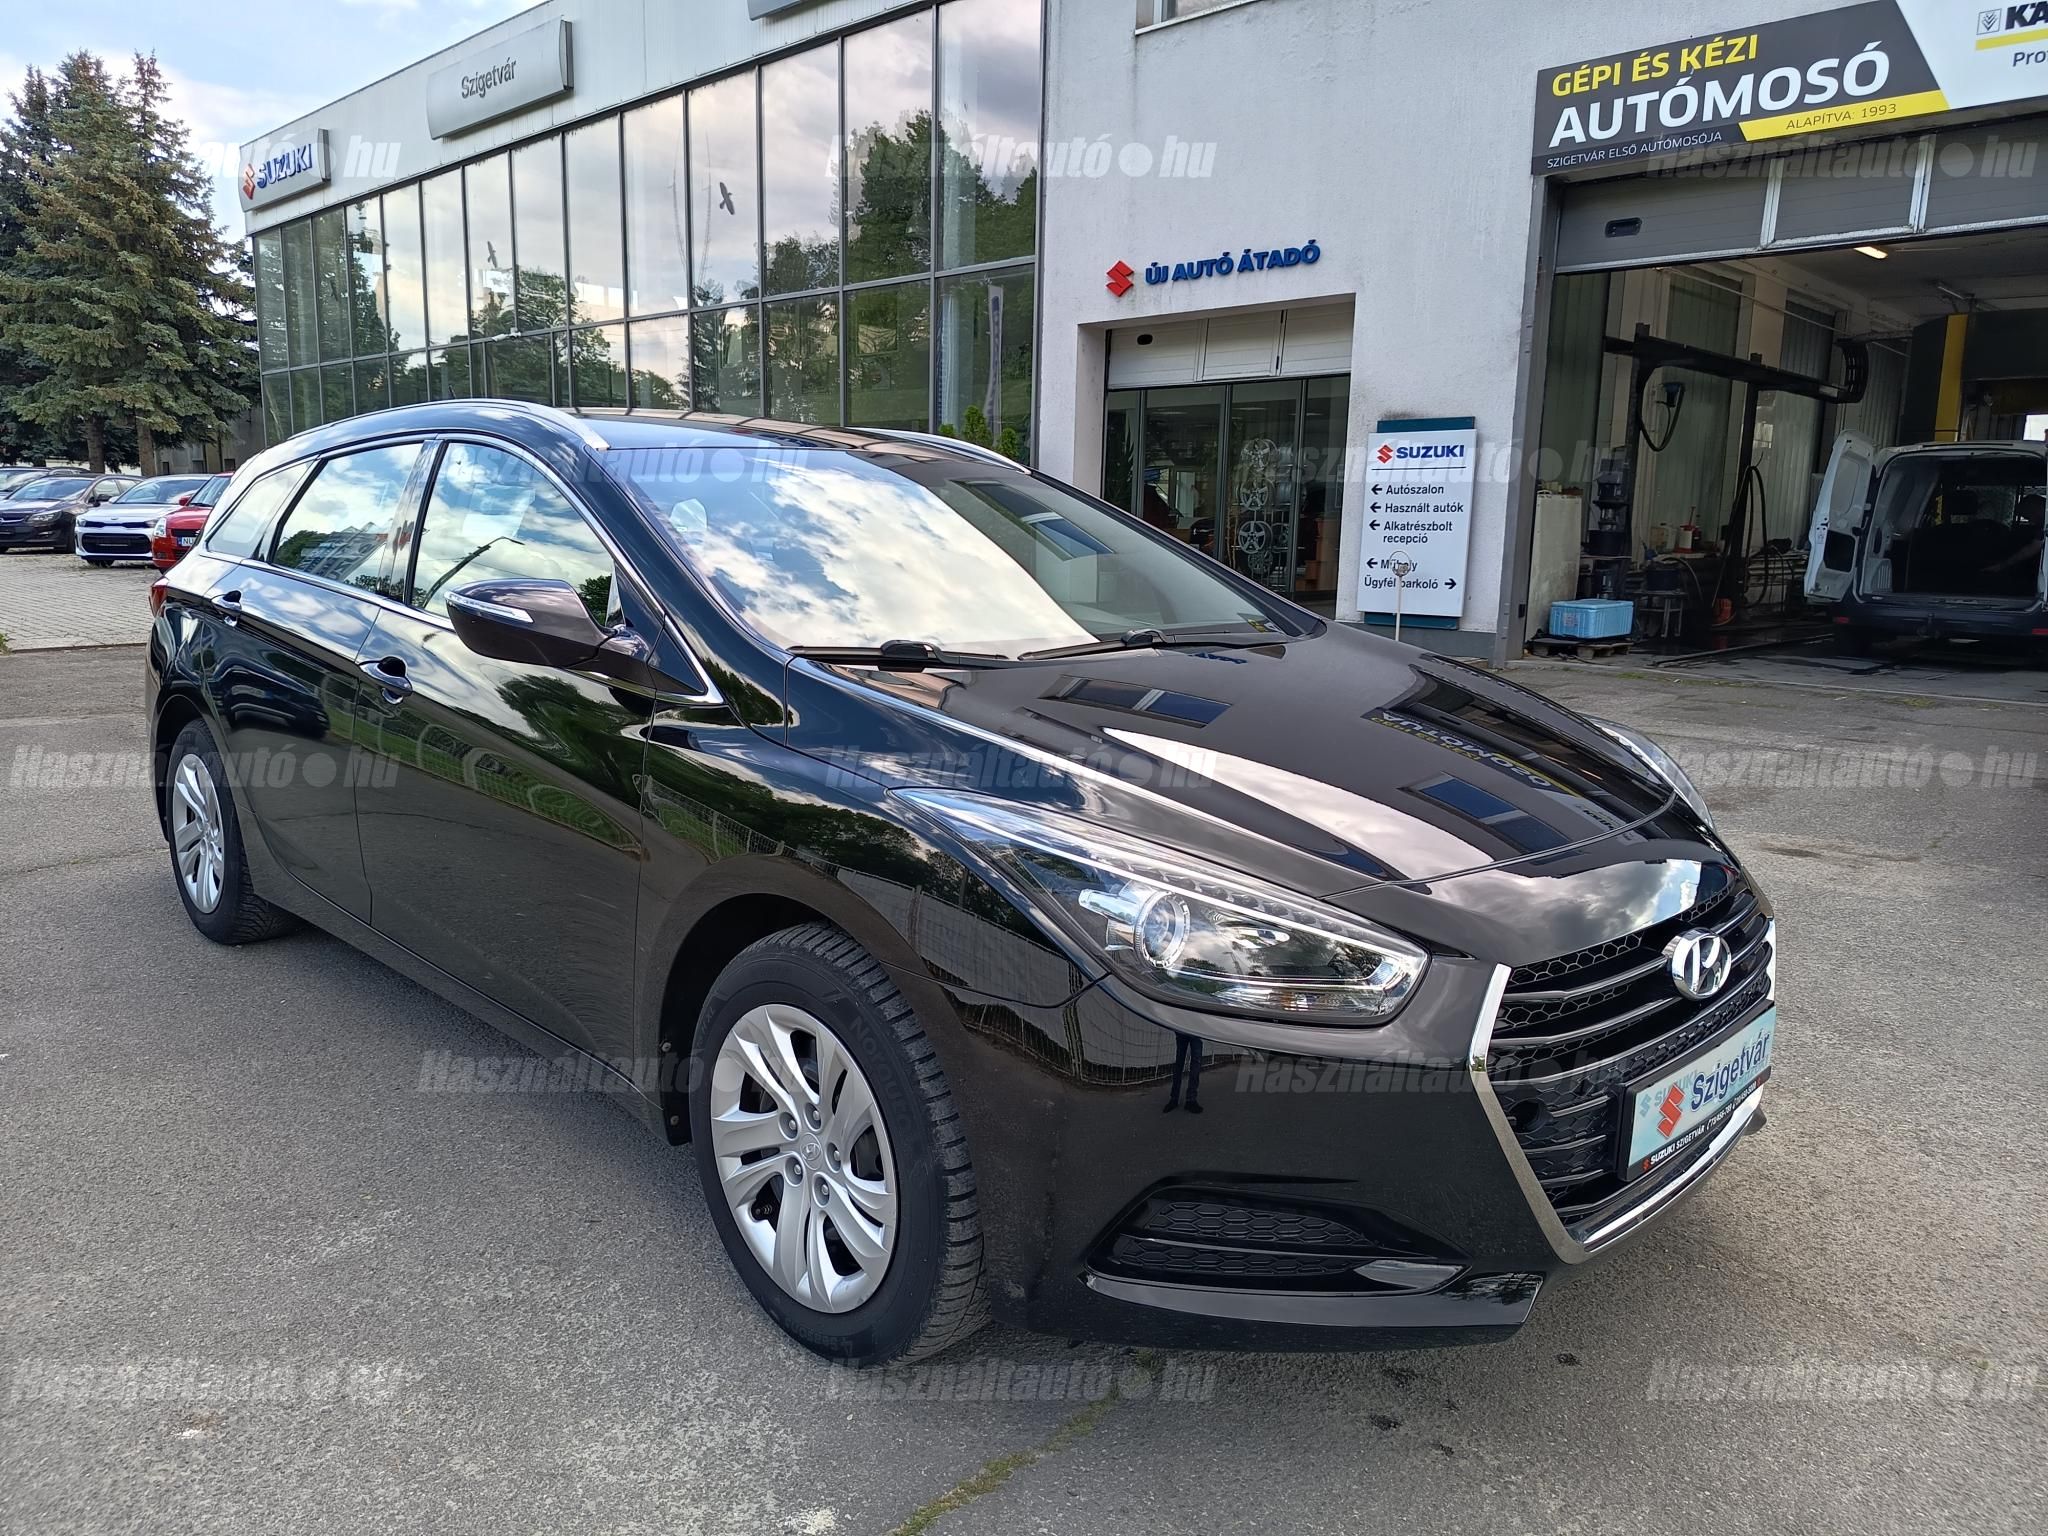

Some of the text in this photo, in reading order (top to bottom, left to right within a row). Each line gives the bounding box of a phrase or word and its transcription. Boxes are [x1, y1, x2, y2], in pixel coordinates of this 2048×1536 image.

[1552, 34, 1757, 97] GÉPI ÉS KÉZI
[2012, 50, 2048, 67] Pro
[461, 57, 517, 99] Szigetvár
[1549, 40, 1890, 148] AUTÓMOSÓ
[1786, 103, 1897, 130] ALAPÍTVA: 1993
[1547, 131, 1722, 169] SZIGETVÁR ELSŐ AUTÓMOSÓJA
[257, 143, 313, 188] SUZUKI
[1145, 239, 1321, 285] ÚJ AUTÓ ÁTADÓ
[1396, 444, 1464, 459] SUZUKI
[1386, 484, 1444, 495] Autószalon
[1384, 502, 1464, 513] Használt autók
[1383, 520, 1453, 532] Alkatrészbolt
[1383, 533, 1428, 545] recepció
[1691, 1032, 1770, 1110] Szigetvár
[1651, 1143, 1675, 1165] SUZUKI
